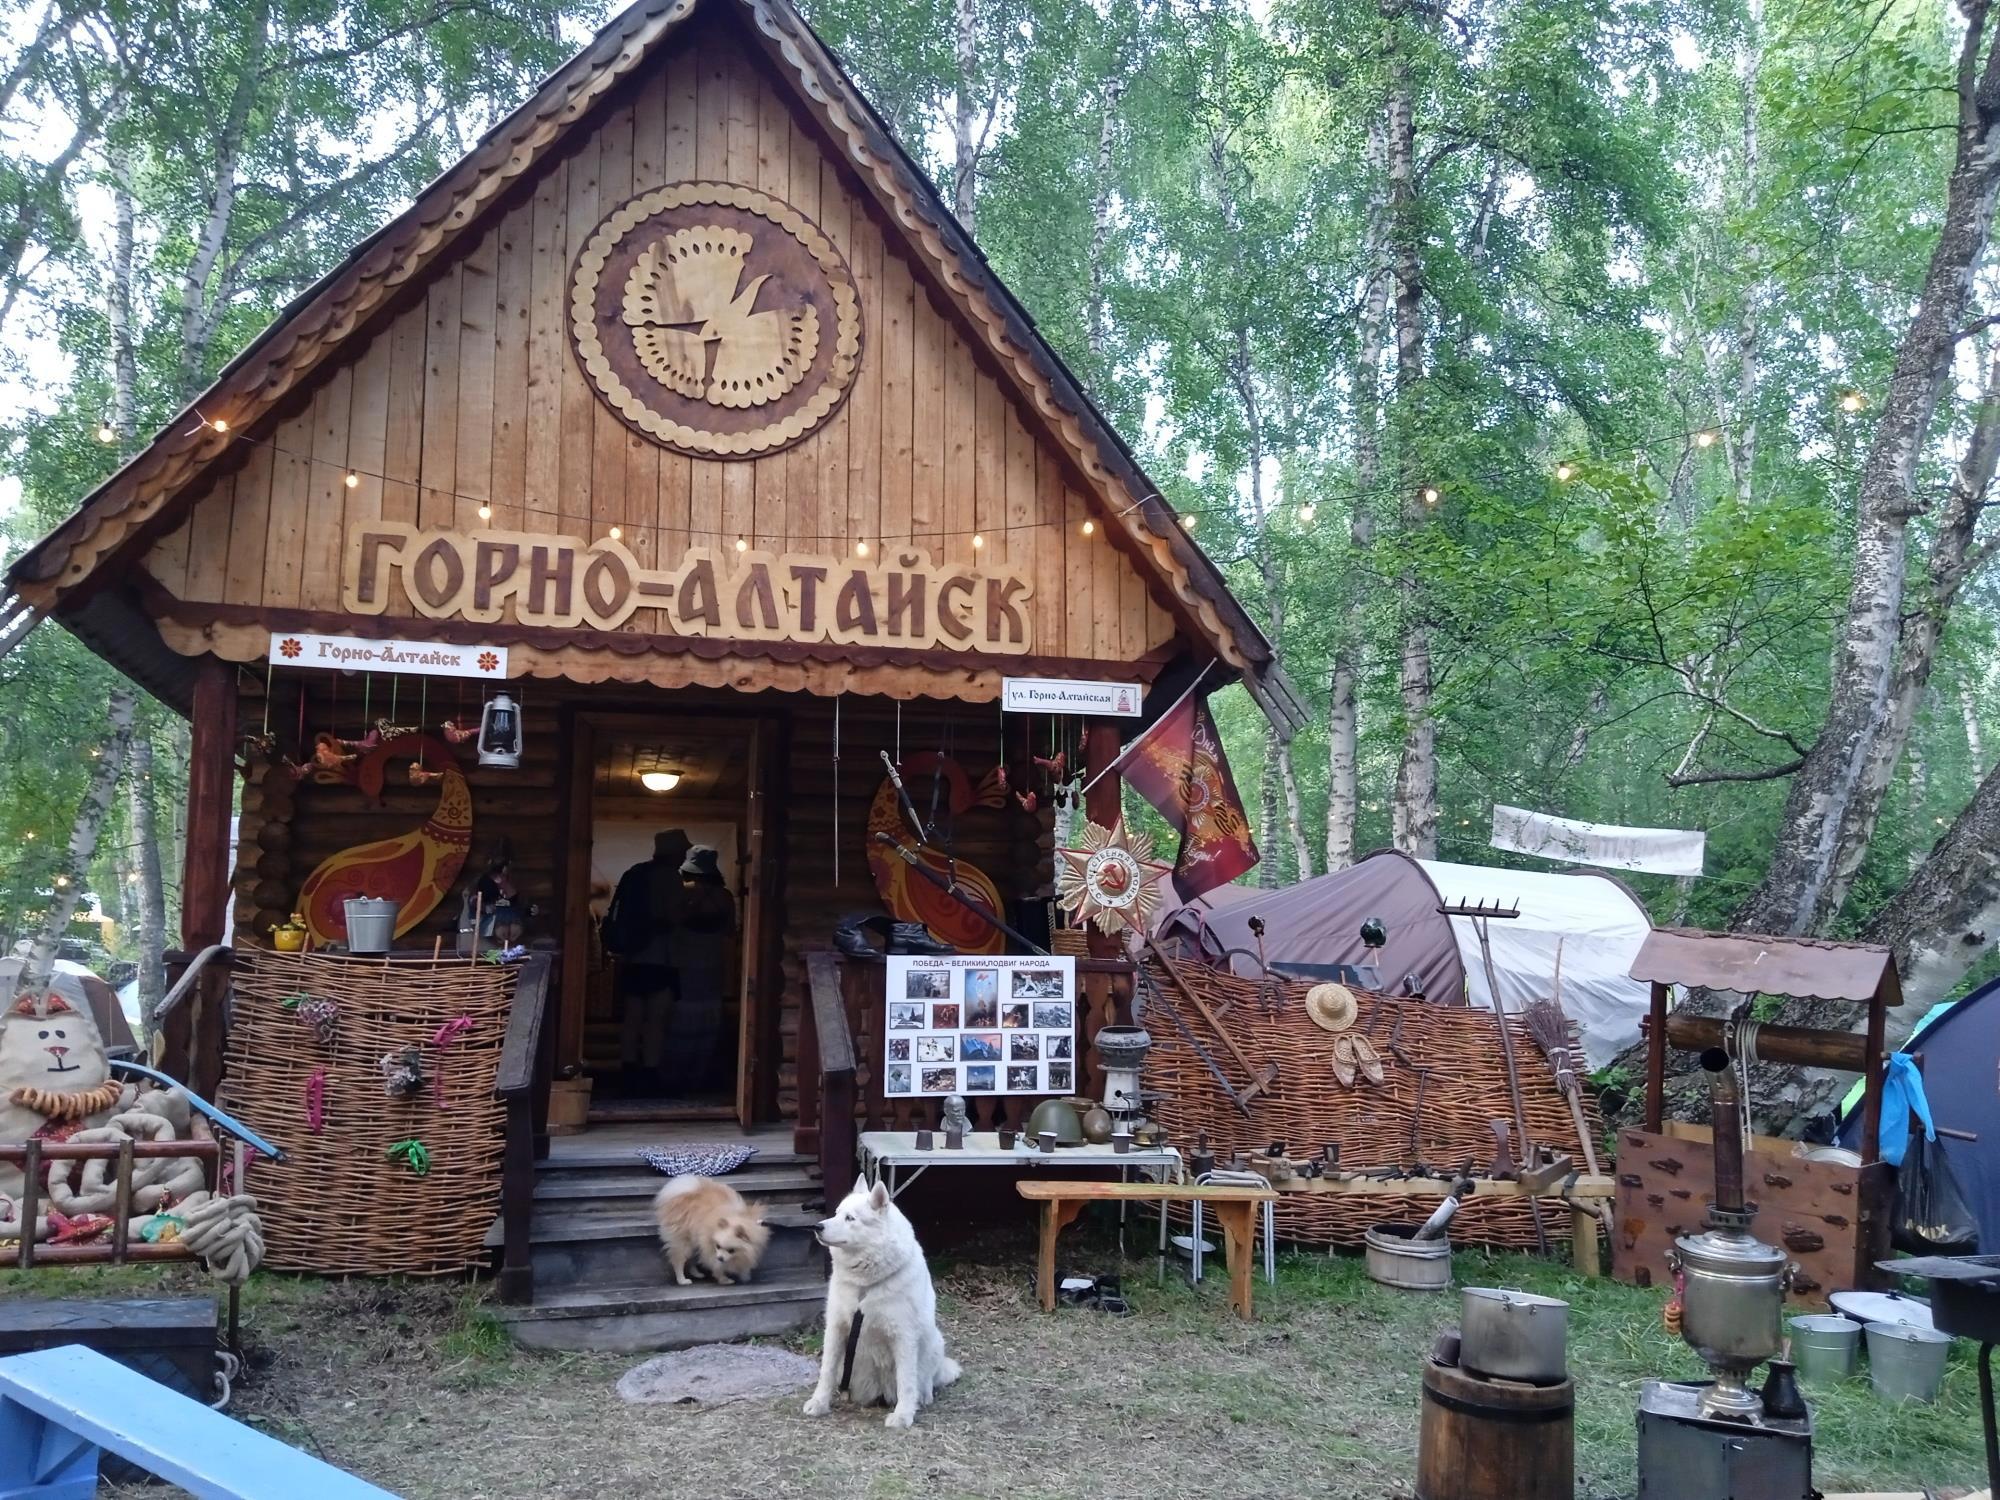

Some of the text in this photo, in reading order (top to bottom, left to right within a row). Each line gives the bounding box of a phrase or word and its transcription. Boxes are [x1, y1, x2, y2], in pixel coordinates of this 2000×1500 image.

[357, 532, 1026, 643] ГОРНО-АЛТАЙСК
[318, 641, 461, 667] Горно-Алтайск
[912, 960, 945, 968] ПОБЕДА
[988, 959, 1017, 968] ПОДВИГ
[1019, 959, 1050, 968] НАРОДА
